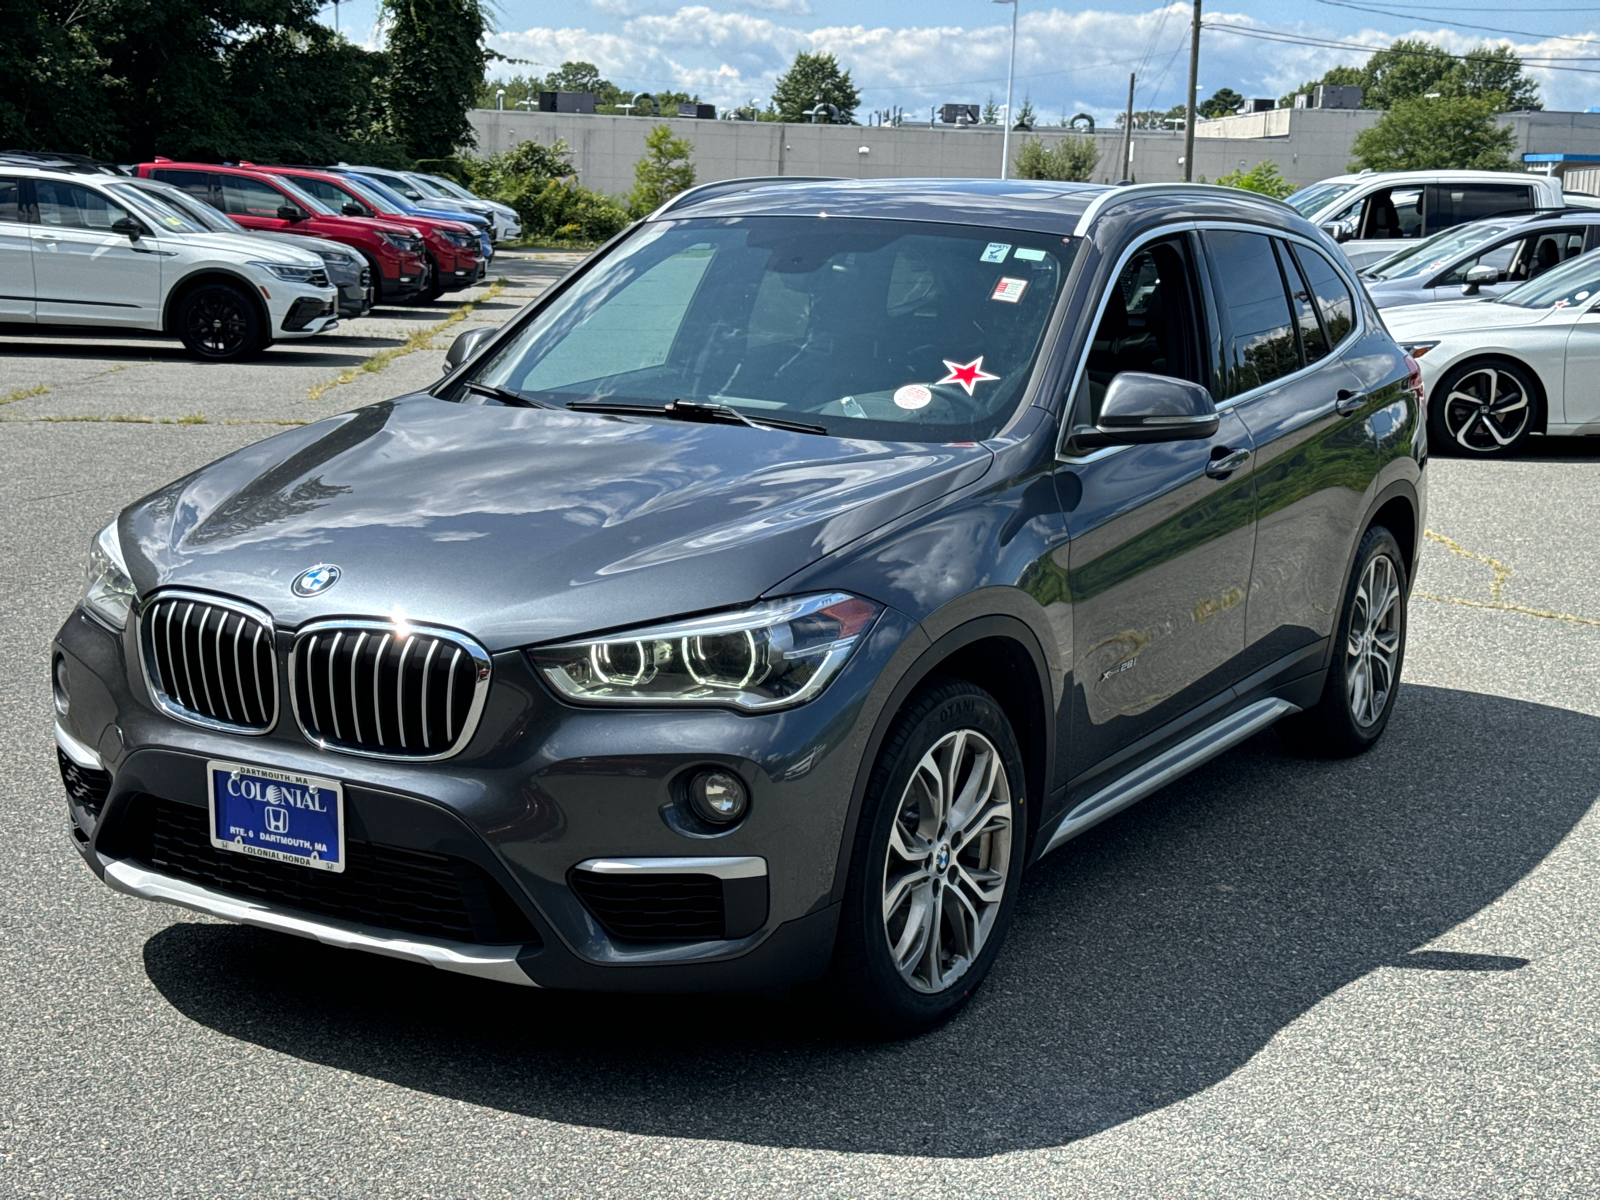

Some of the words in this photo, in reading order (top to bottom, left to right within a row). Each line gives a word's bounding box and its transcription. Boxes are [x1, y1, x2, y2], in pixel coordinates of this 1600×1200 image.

[940, 700, 975, 722] OTANI
[240, 766, 293, 783] DARTMOUTH,
[295, 777, 308, 785] MA
[227, 778, 327, 812] COLONIAL
[229, 826, 247, 837] RTE.
[248, 830, 254, 838] 6
[259, 832, 312, 850] DARTMOUTH,
[314, 842, 328, 852] MA
[242, 846, 280, 860] COLONIAL
[282, 854, 311, 866] HONDA
